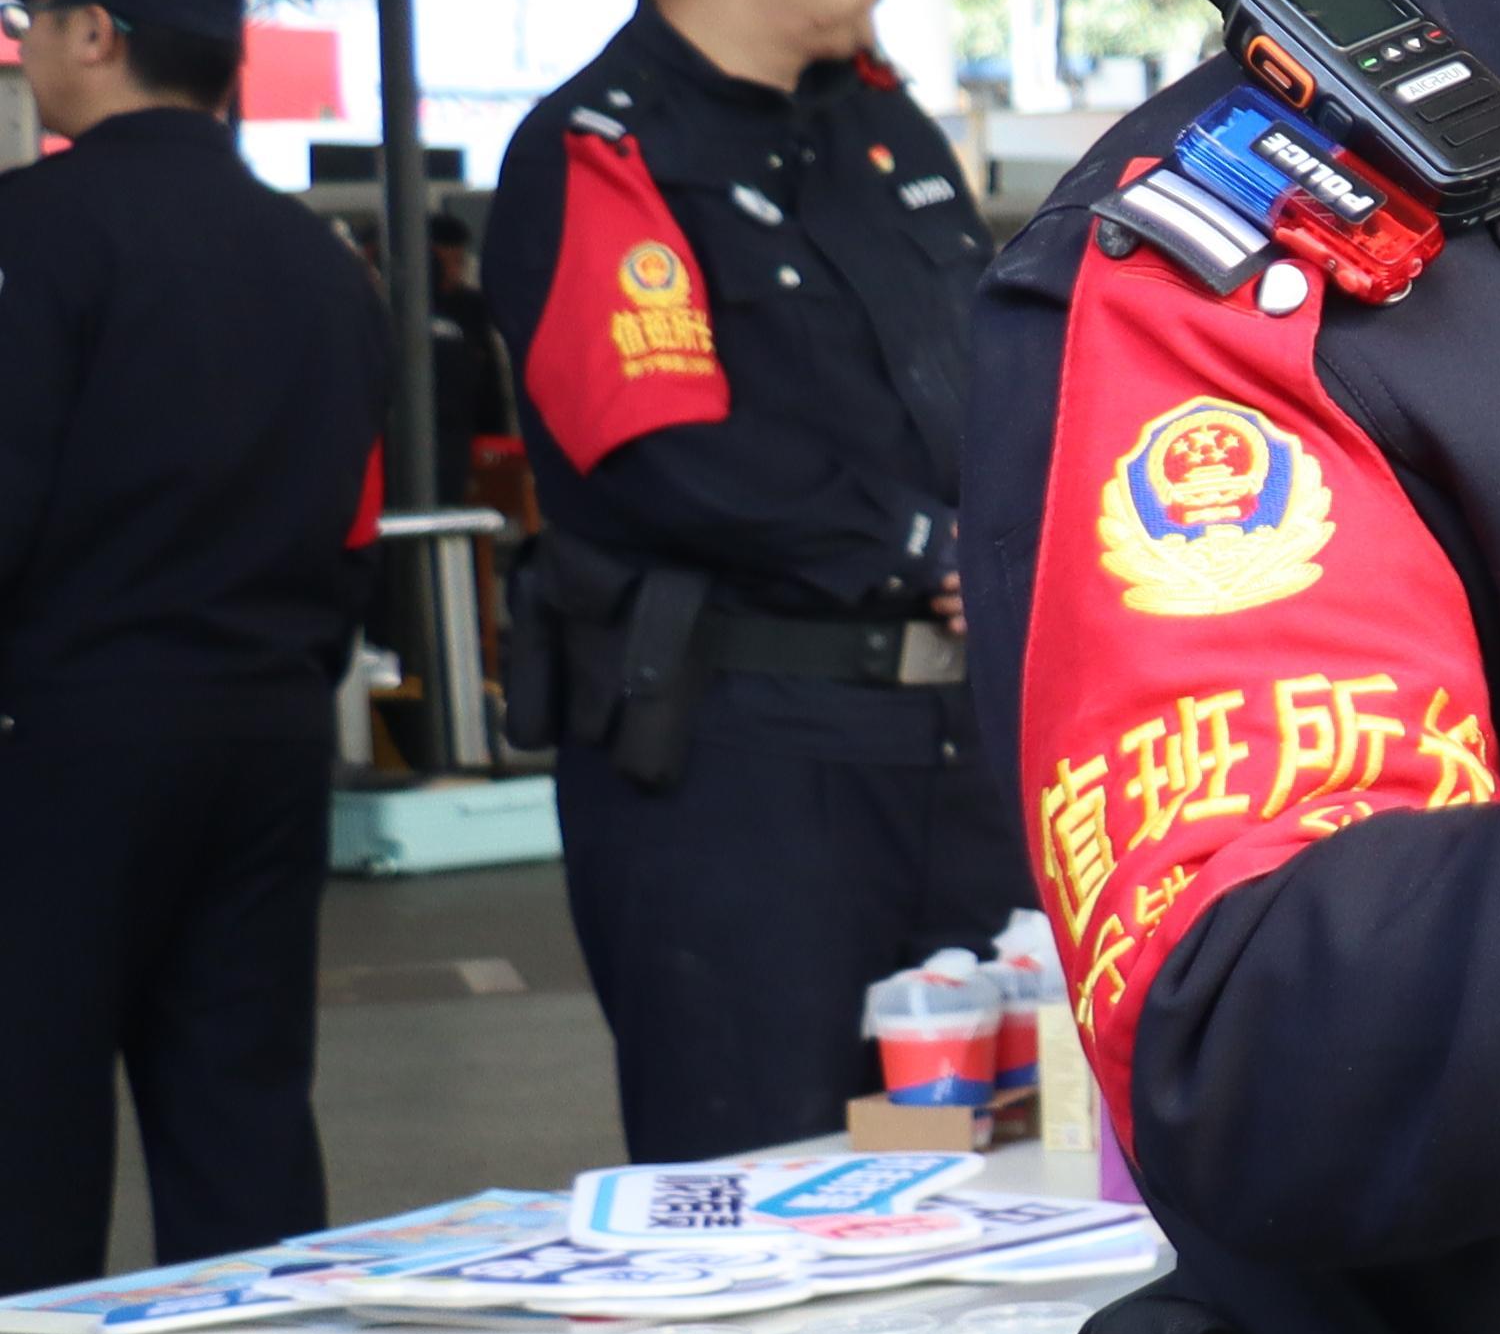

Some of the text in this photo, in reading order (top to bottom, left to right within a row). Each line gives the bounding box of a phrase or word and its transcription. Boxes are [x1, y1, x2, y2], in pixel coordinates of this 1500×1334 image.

[1262, 132, 1375, 212] POLICE
[1043, 672, 1496, 947] 值班所长
